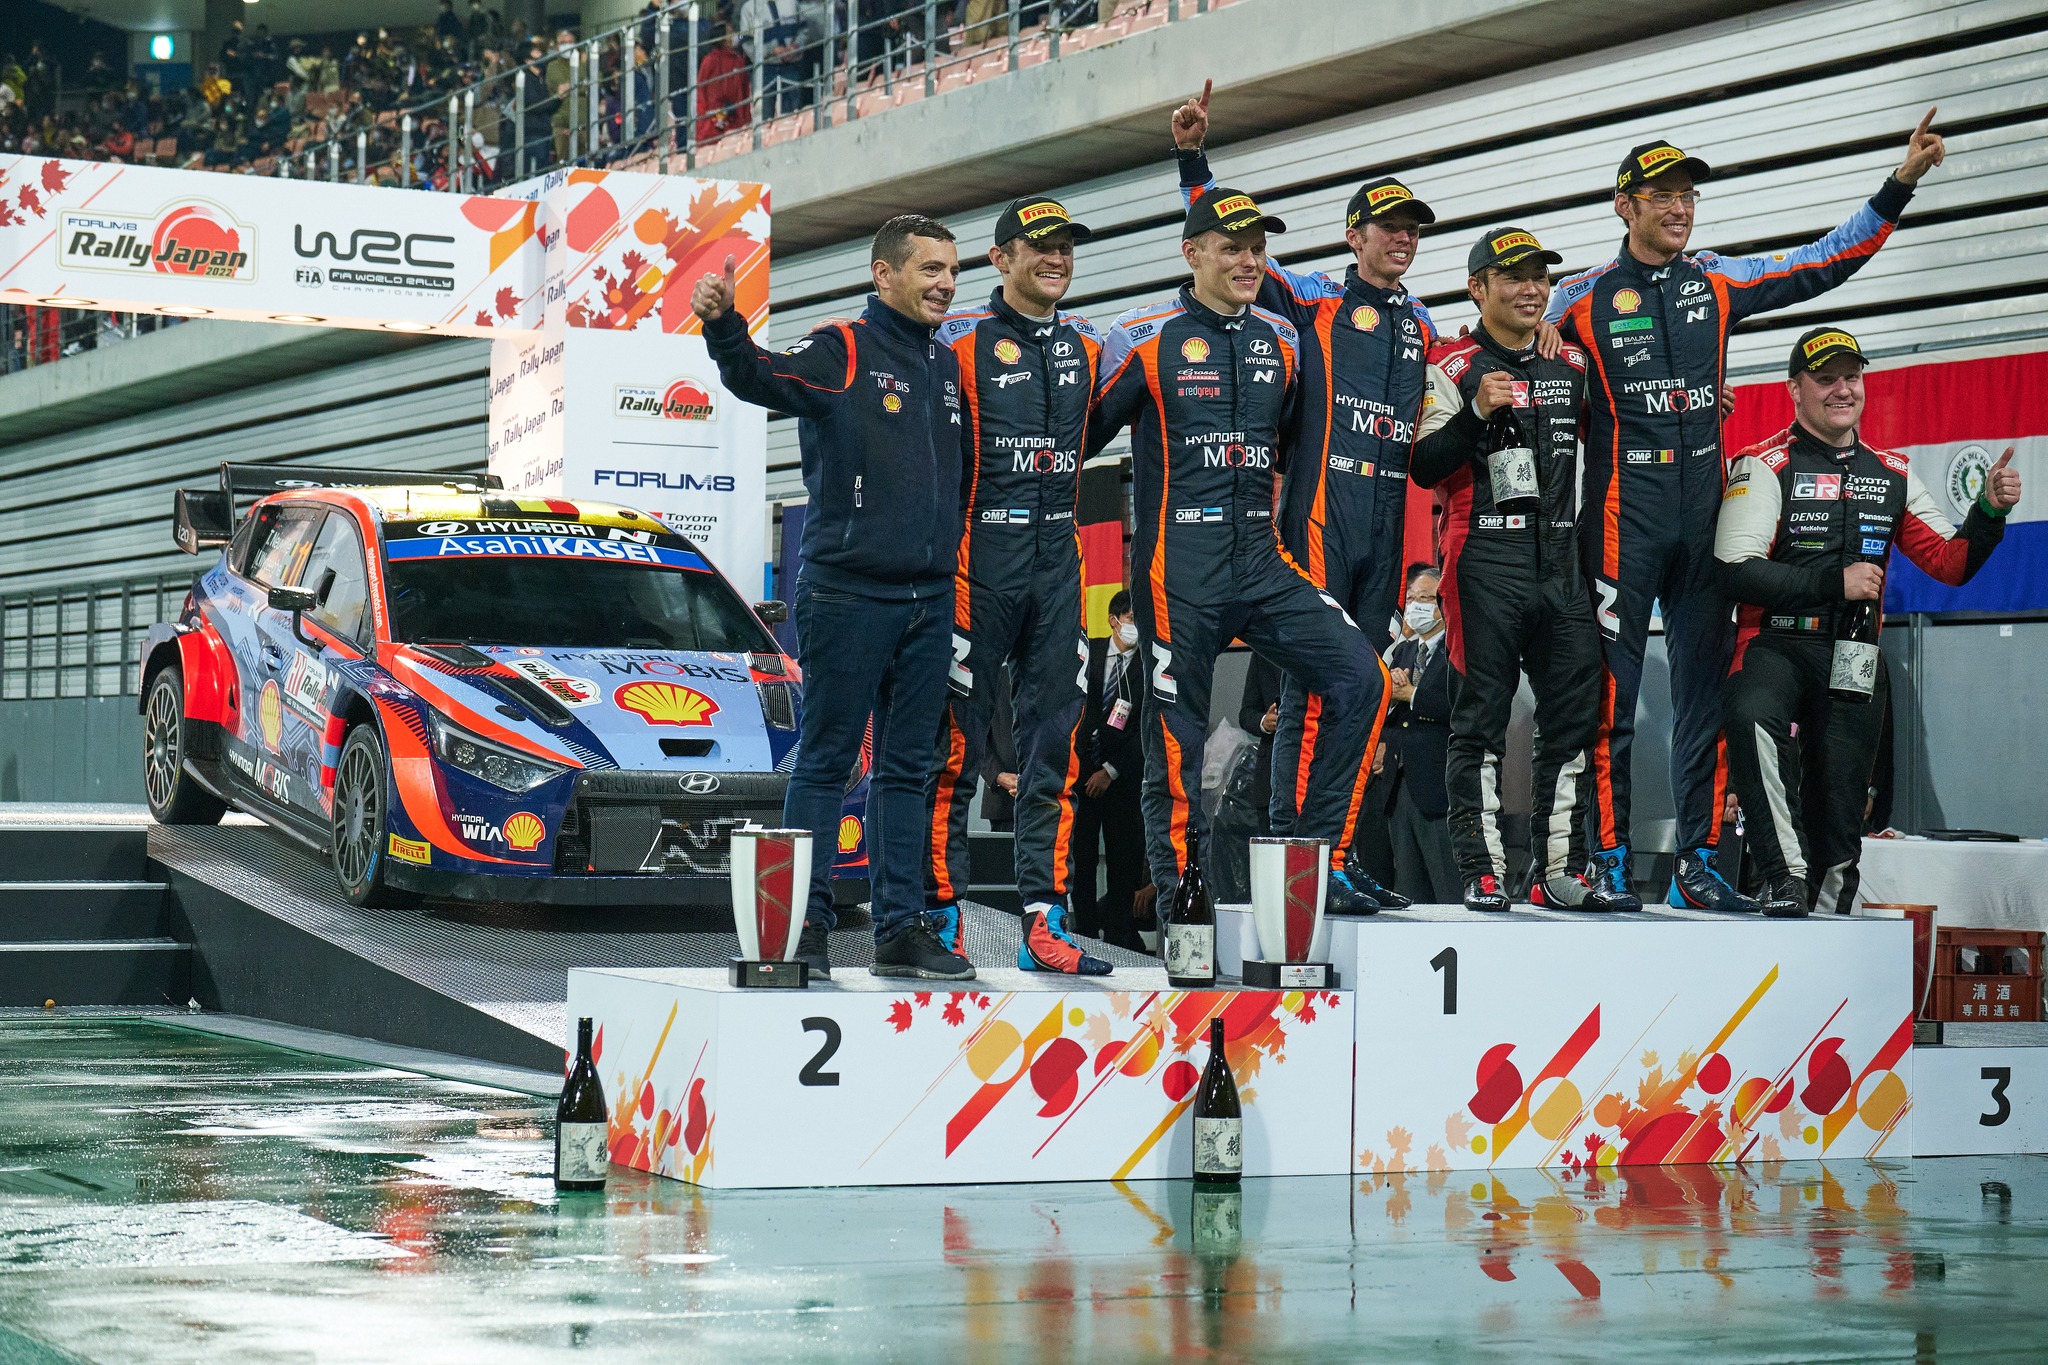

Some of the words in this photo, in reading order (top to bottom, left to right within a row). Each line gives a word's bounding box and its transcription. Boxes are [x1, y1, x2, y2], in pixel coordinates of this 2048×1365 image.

[1617, 170, 1632, 189] 1ST
[68, 218, 137, 231] FORUM8
[68, 231, 152, 267] Rally
[155, 239, 248, 271] Japan
[294, 224, 455, 269] WRC
[205, 266, 233, 277] 2022
[331, 271, 352, 281] FIA
[354, 273, 402, 285] WORLD
[406, 277, 454, 289] RALLY
[332, 285, 452, 299] CHAMPIONSHIP
[1568, 281, 1590, 297] OMP
[1675, 293, 1712, 309] HYUNDAI
[949, 320, 971, 333] OMP
[1130, 324, 1154, 338] OMP
[1279, 326, 1297, 339] OMP
[1624, 335, 1655, 343] BAUMA
[520, 355, 540, 379] Rally
[541, 341, 564, 365] Japan
[1245, 357, 1280, 367] HYUNDAI
[1446, 357, 1466, 376] OMP
[877, 378, 910, 393] MOBIS
[1185, 385, 1213, 398] redgrey
[1534, 380, 1573, 389] TOYOTA
[1624, 378, 1685, 393] HYUNDAI
[619, 396, 663, 415] Rally
[665, 400, 713, 417] Japan
[1335, 394, 1394, 415] HYUNDAI
[1644, 385, 1714, 414] MOBIS
[504, 427, 523, 447] Rally
[524, 411, 546, 434] Japan
[1351, 410, 1414, 444] MOBIS
[995, 437, 1056, 449] HYUNDAI
[1185, 432, 1245, 445] HYUNDAI
[1011, 449, 1077, 474] MOBIS
[1203, 445, 1270, 469] MOBIS
[1329, 457, 1354, 470] OMP
[1626, 452, 1652, 462] OMP
[1766, 452, 1786, 466] OMP
[525, 468, 544, 489] Rally
[546, 457, 563, 479] Japa
[1848, 474, 1891, 486] TOYOTA
[594, 469, 735, 492] FORUM8
[1795, 484, 1838, 498] GR
[1845, 482, 1887, 494] GAZOO
[666, 513, 718, 523] TOYOTA
[981, 510, 1007, 522] OMP
[1176, 510, 1201, 521] OMP
[1478, 516, 1504, 527] OMP
[1790, 512, 1829, 522] DENSO
[1858, 512, 1893, 523] Panasonic
[476, 521, 596, 536] HYUNDAI
[1800, 525, 1829, 533] McKelvey
[1771, 617, 1796, 627] OMP
[551, 653, 675, 663] HYUNDAI
[518, 663, 552, 681] Rally
[600, 660, 750, 683] MOBIS
[254, 757, 291, 805] MOBIS
[451, 813, 485, 824] HYUNDAI
[393, 838, 426, 860] PIRELLI
[1429, 946, 1458, 1015] 1
[1972, 983, 2011, 1001] 清酒
[798, 1016, 842, 1087] 2
[1978, 1067, 2011, 1127] 3
